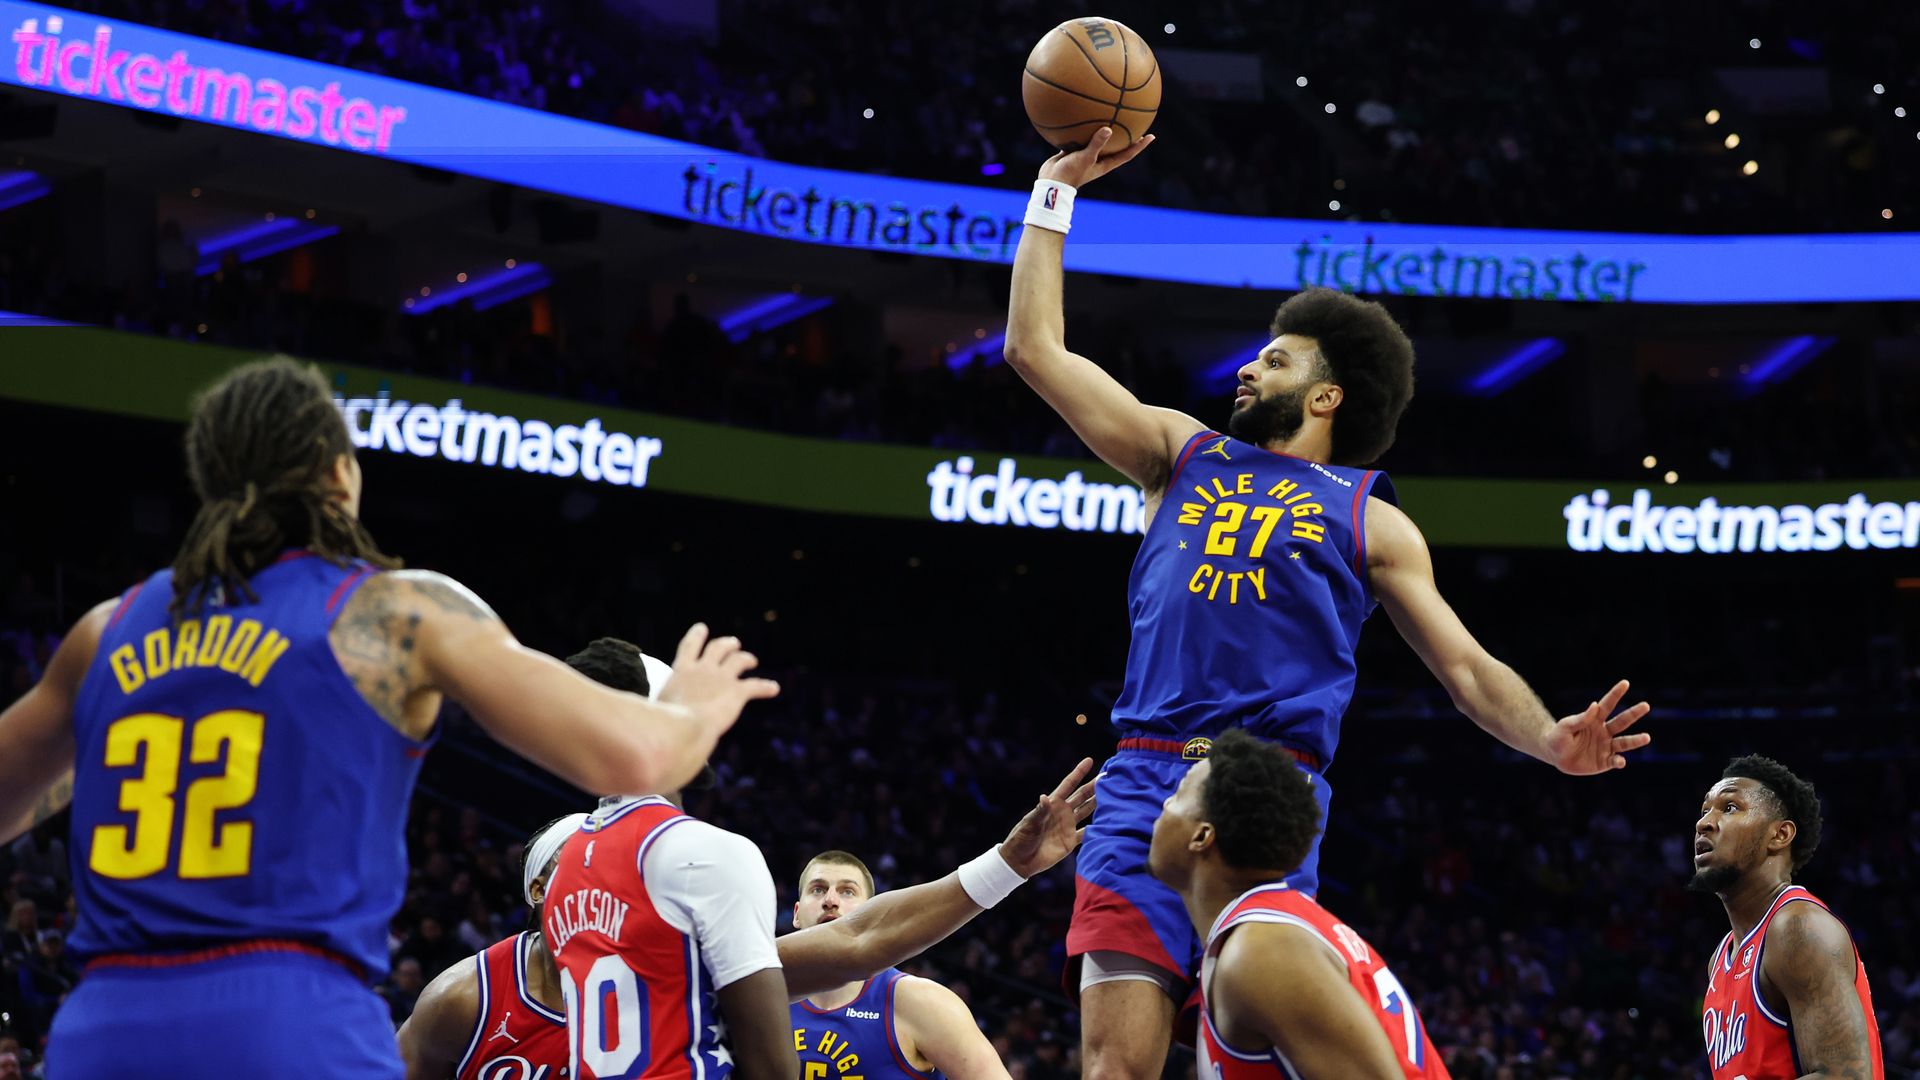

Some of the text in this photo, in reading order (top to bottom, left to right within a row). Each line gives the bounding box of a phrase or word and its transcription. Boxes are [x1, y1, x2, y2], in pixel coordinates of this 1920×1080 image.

[13, 16, 406, 153] ticketmaster
[682, 163, 1024, 260] ticketmaster
[1295, 235, 1647, 302] ticketmaster
[927, 456, 1145, 536] ticketm
[1177, 473, 1325, 544] MILE HIGH
[1310, 462, 1352, 488] ibotta
[1204, 501, 1286, 558] 27
[1188, 563, 1266, 604] CITY
[109, 615, 290, 694] GORDON
[89, 709, 264, 880] 32
[548, 888, 629, 957] JACKSON
[846, 1007, 880, 1020] ibotta
[1703, 999, 1746, 1071] Phila
[817, 1030, 864, 1080] HIG
